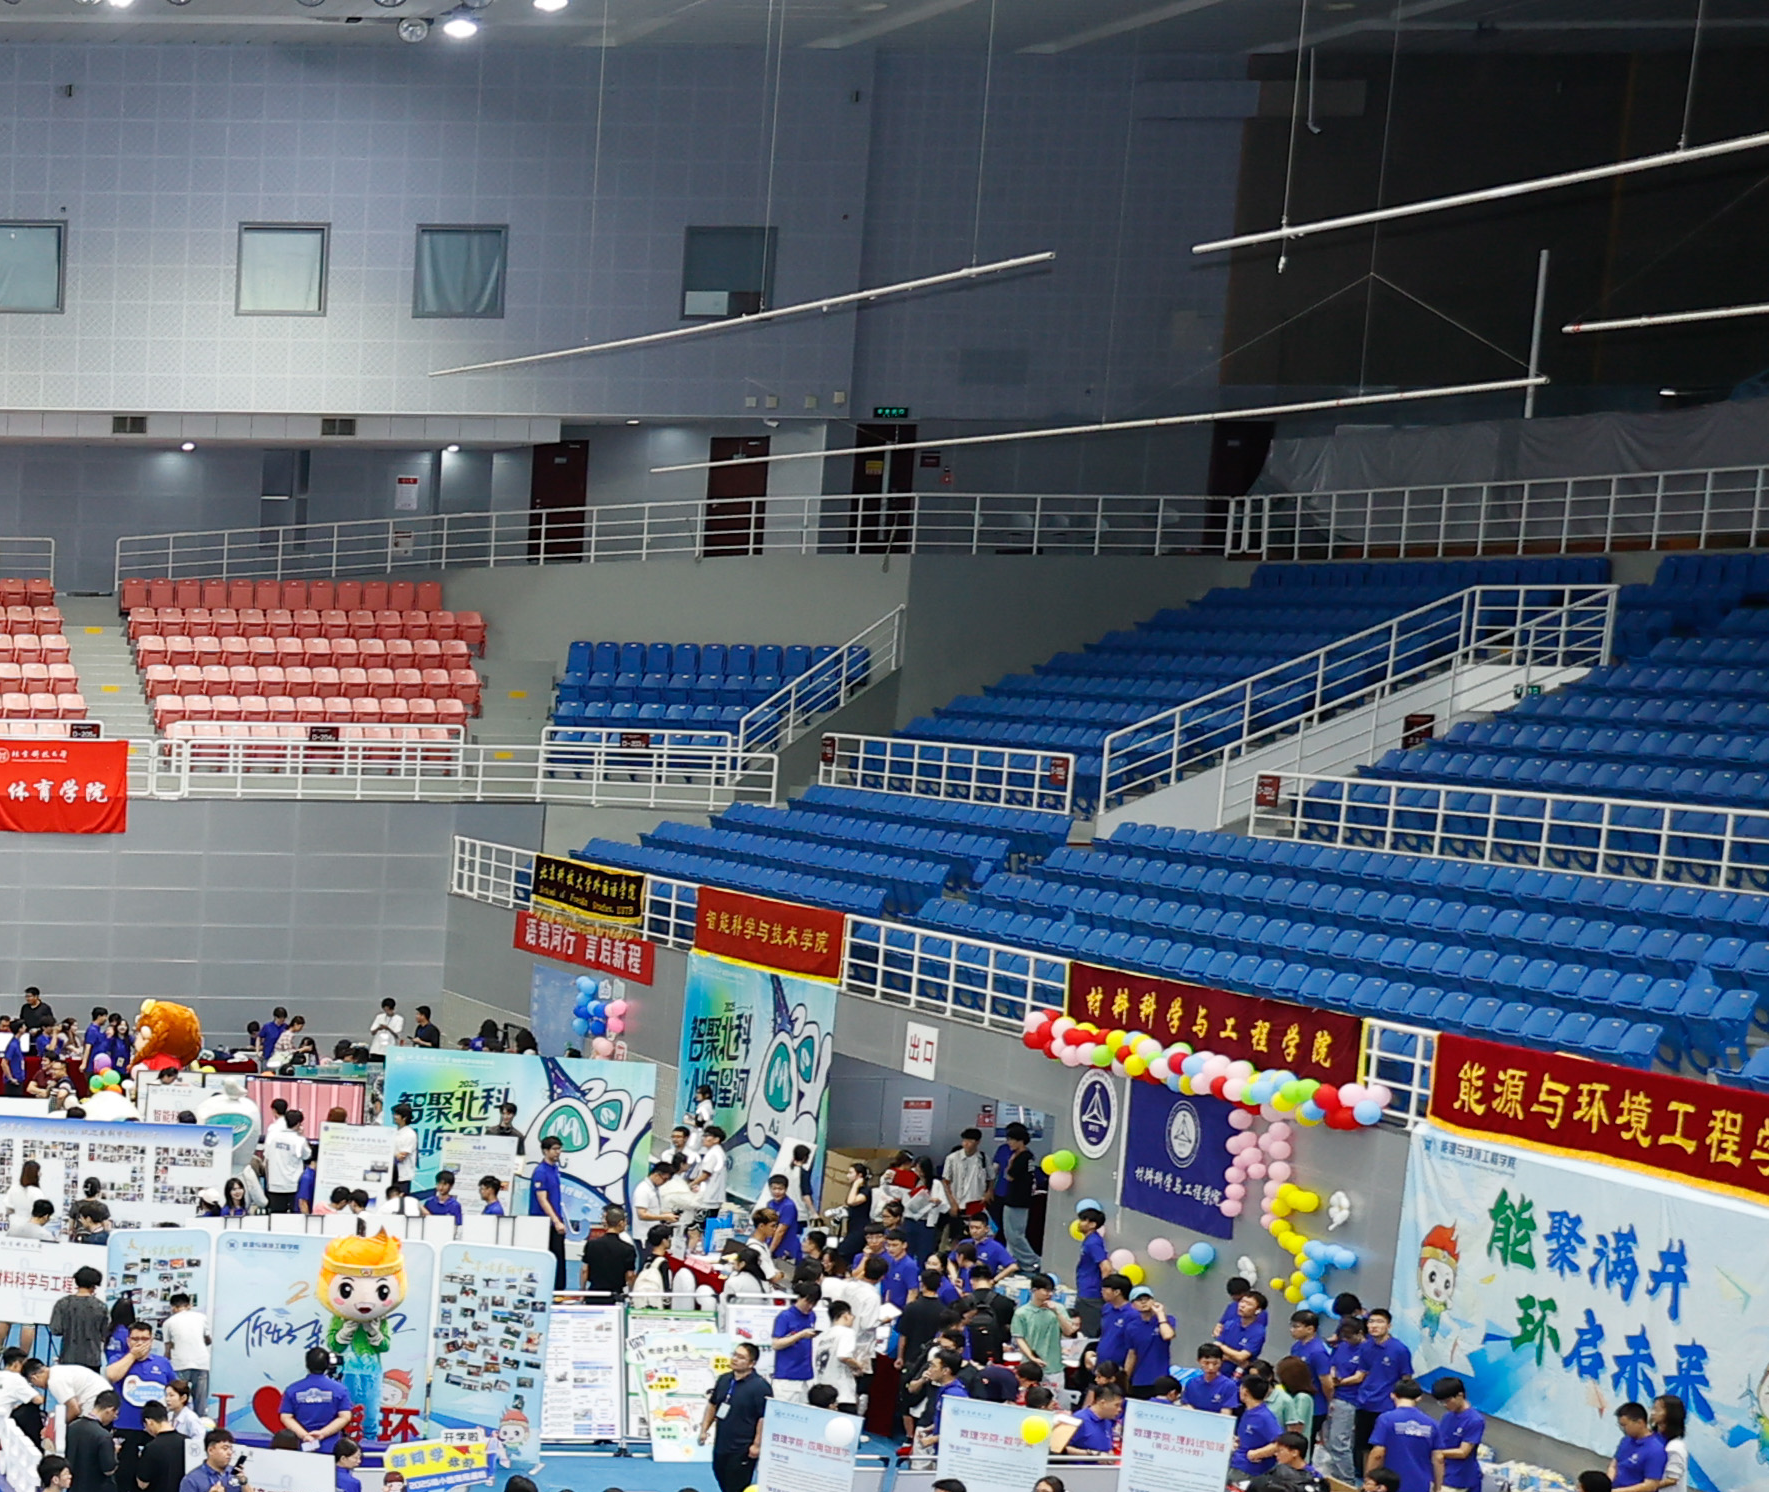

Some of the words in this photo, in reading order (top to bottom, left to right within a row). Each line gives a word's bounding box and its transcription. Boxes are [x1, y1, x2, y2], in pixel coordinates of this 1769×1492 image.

[6, 777, 108, 804] 体育学院
[539, 864, 636, 901] 北京科技大学外国语学院
[705, 909, 830, 954] 智能科学与技术学院
[584, 934, 643, 975] 言启新程
[688, 1013, 753, 1064] 智聚北科
[1086, 985, 1333, 1068] 材料科学与工程学院
[908, 1033, 934, 1064] 出口
[1134, 1165, 1223, 1207] 材料科学与工程学院
[1486, 1187, 1692, 1323] 能聚满井
[1509, 1293, 1717, 1426] 环启未来
[391, 1447, 445, 1468] 新同学
